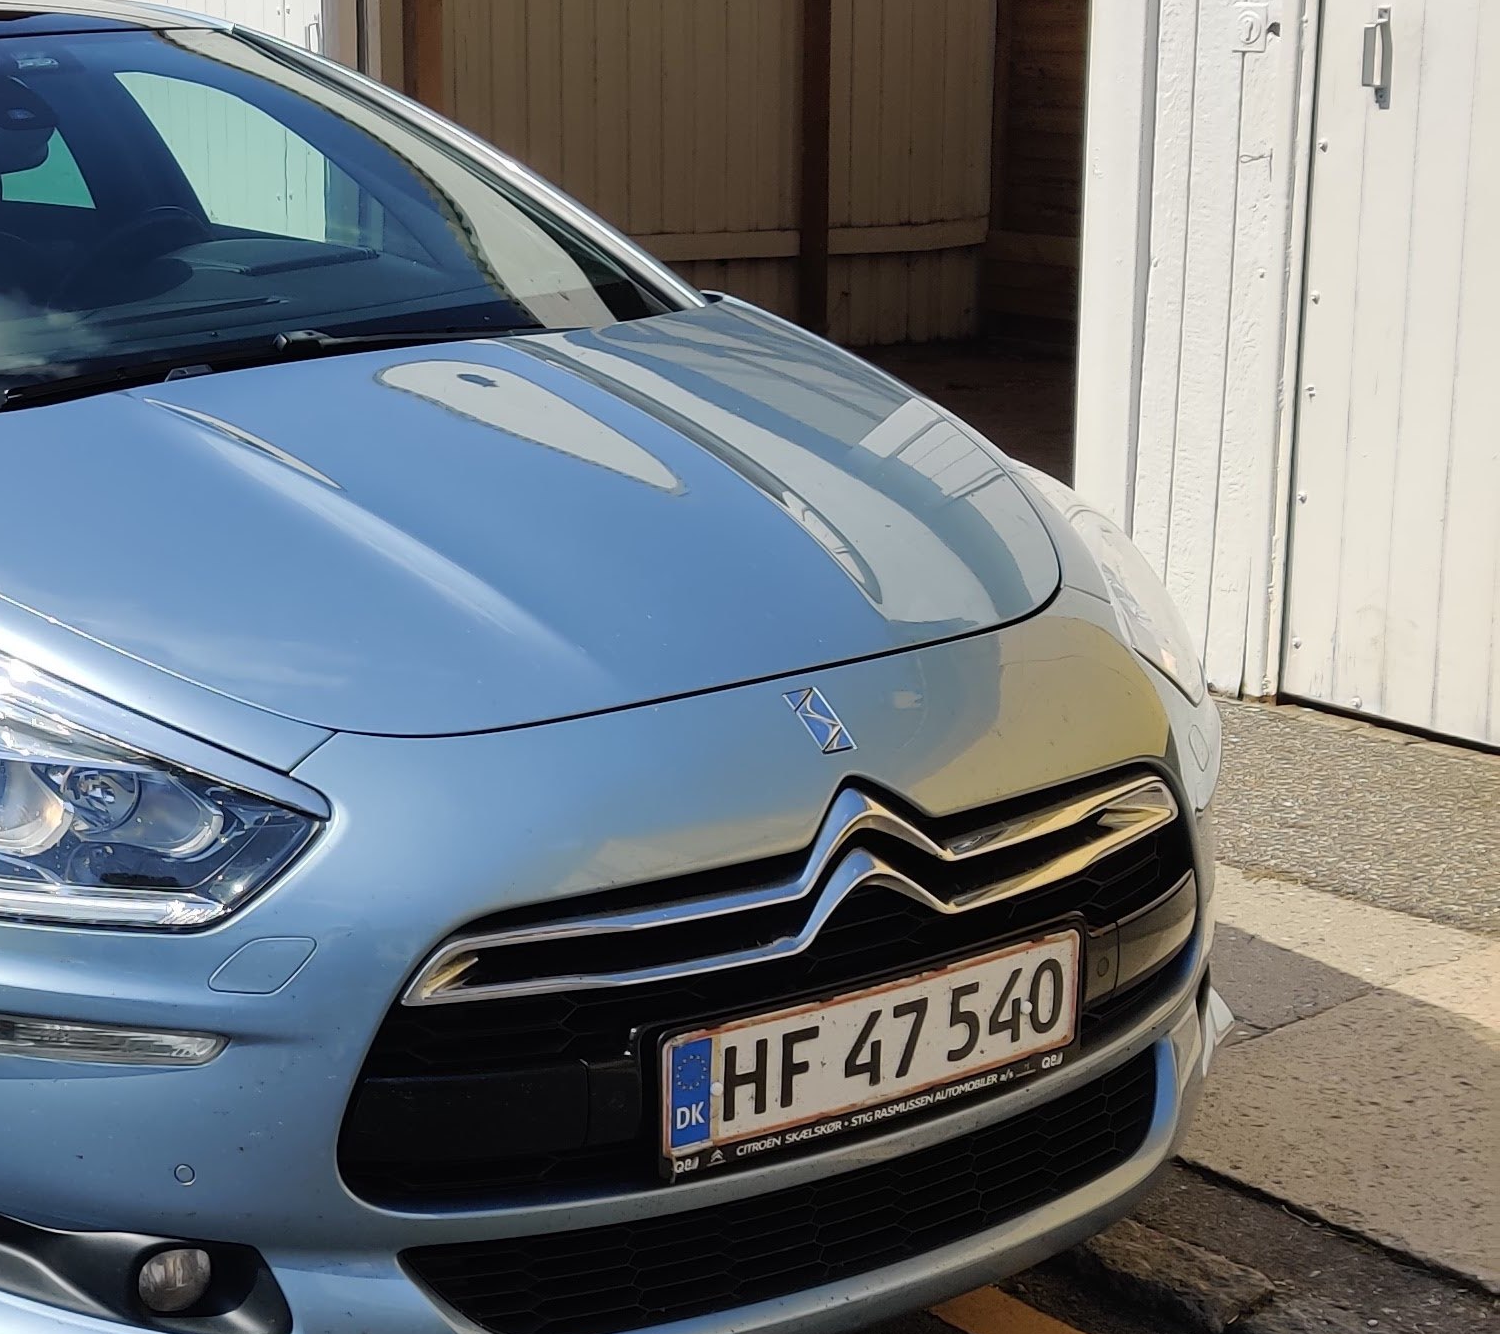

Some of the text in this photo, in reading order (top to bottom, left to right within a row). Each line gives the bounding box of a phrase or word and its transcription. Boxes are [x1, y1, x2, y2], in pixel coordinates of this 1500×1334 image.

[723, 958, 1064, 1122] HF 47 540
[676, 1101, 704, 1130] DK
[736, 1136, 782, 1157] CITROËN
[785, 1121, 842, 1145] SKÆLSKØR
[851, 1111, 873, 1127] STIG
[874, 1092, 934, 1121] RASMUSSEN
[934, 1074, 998, 1102] AUTOMOBILER
